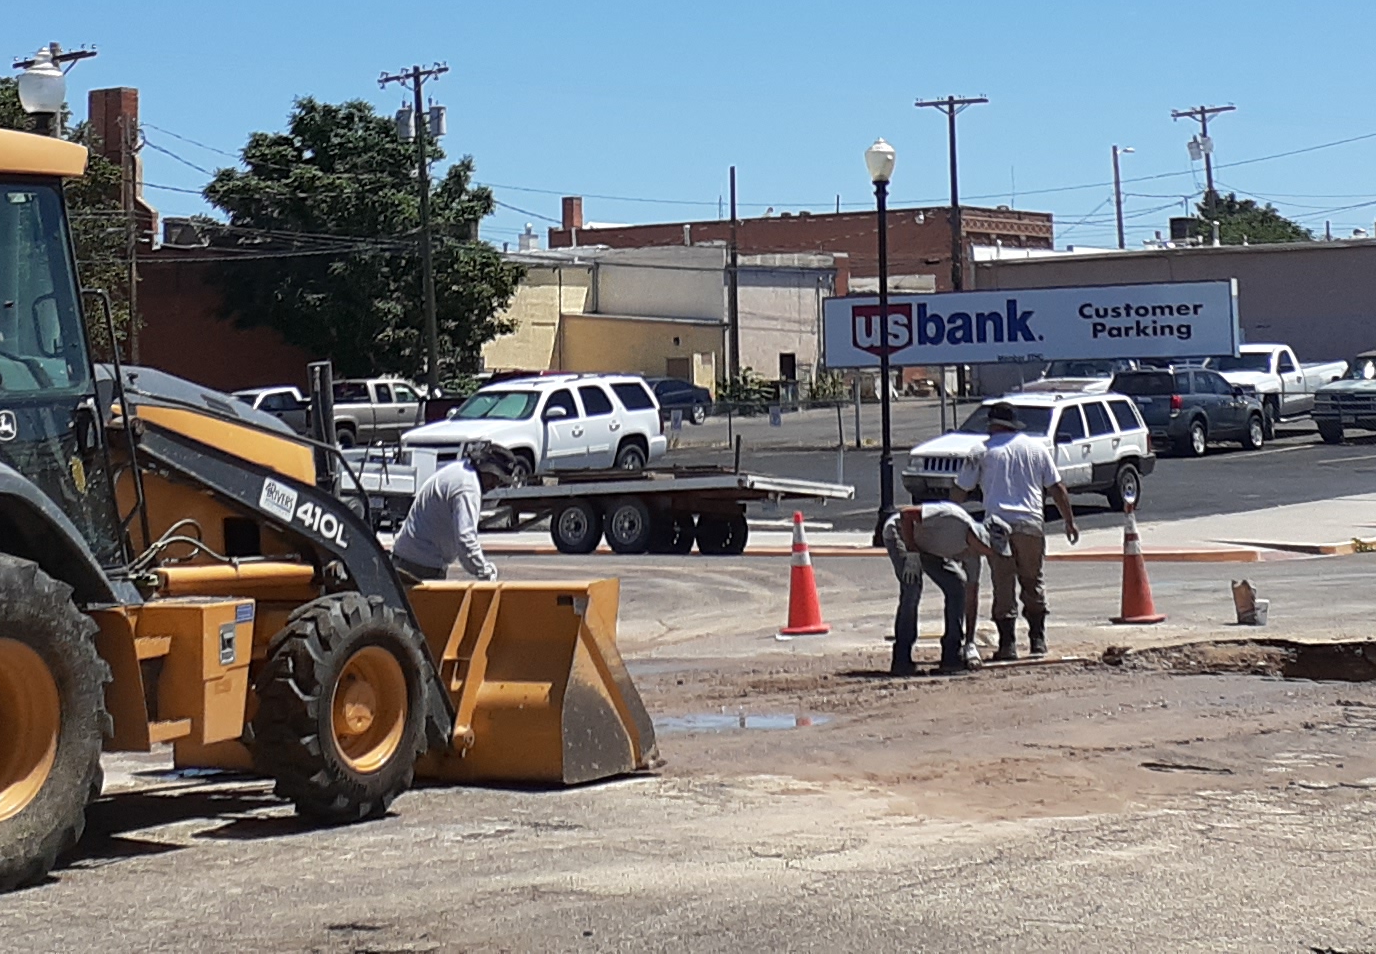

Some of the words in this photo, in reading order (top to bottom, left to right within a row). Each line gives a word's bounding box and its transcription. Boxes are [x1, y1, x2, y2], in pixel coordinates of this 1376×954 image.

[1077, 302, 1204, 320] Customer
[1091, 320, 1193, 340] Parking
[295, 501, 348, 549] 410L
